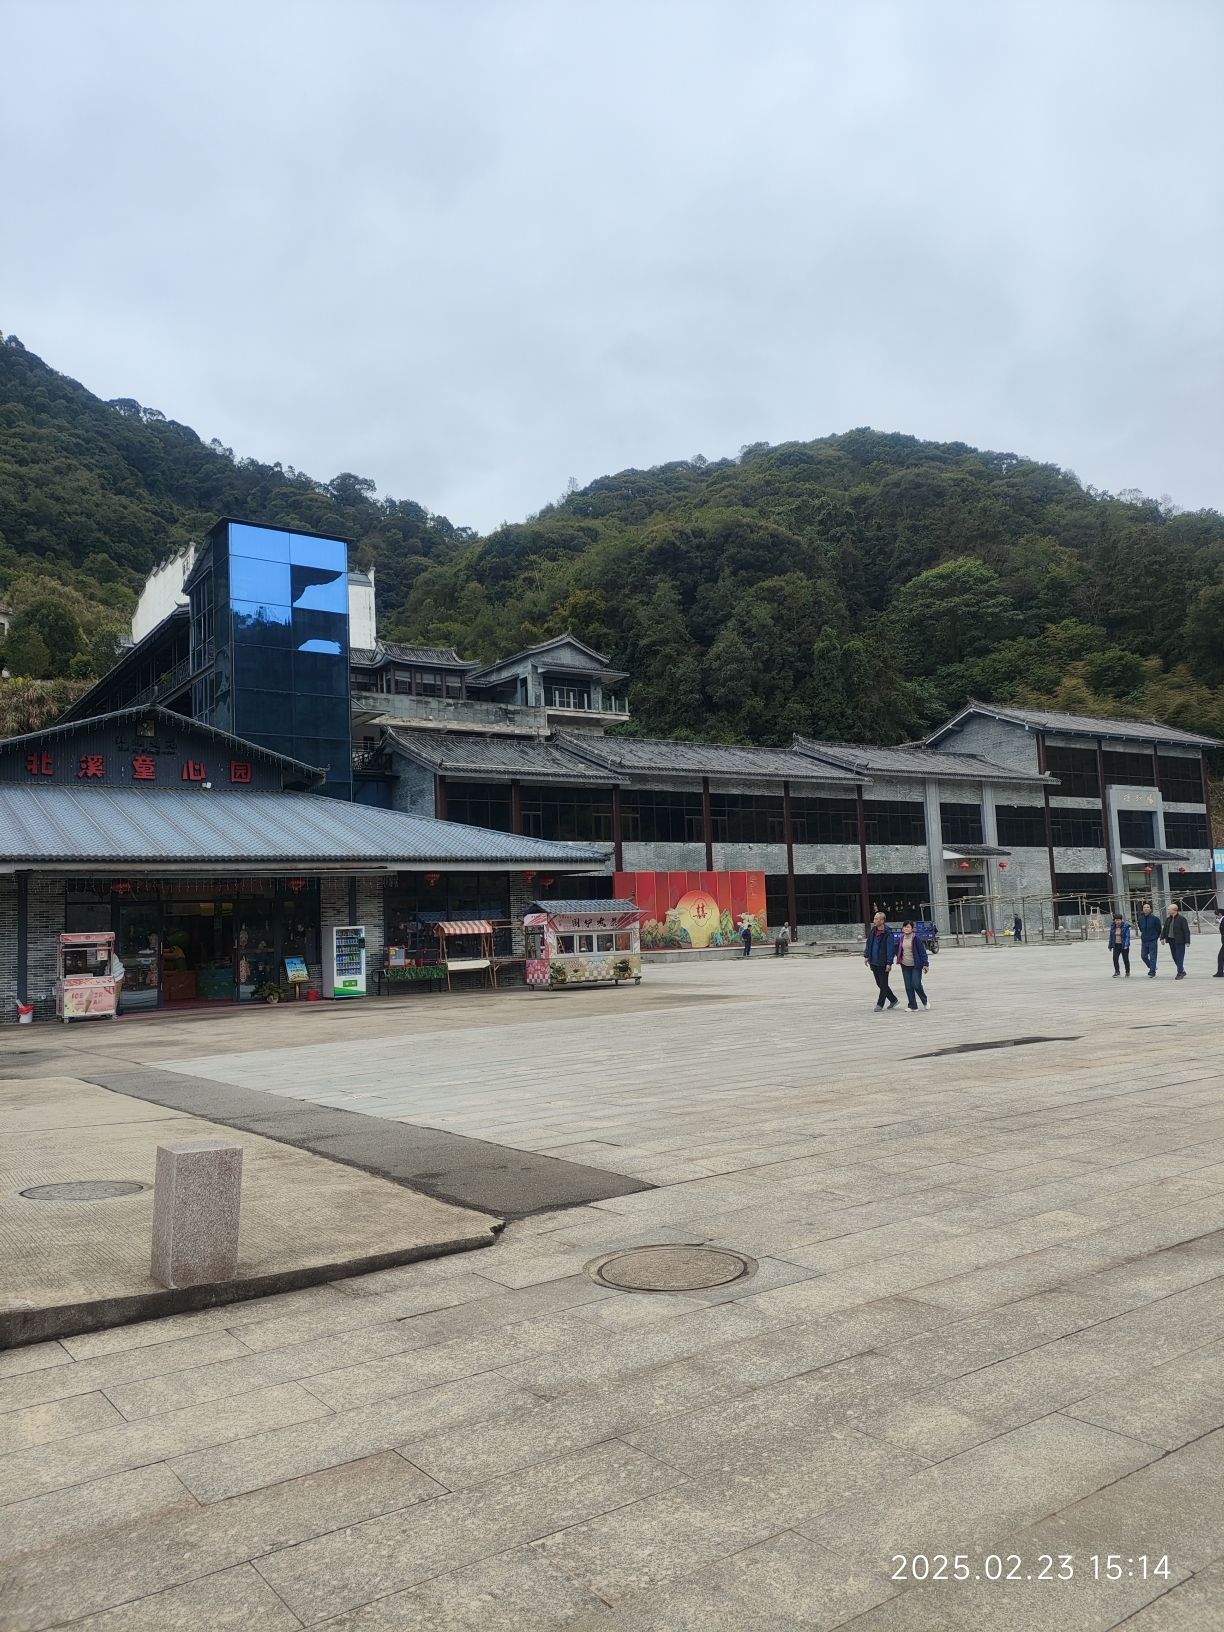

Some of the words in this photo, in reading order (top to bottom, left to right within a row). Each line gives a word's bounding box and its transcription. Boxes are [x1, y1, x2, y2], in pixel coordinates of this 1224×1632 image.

[26, 753, 252, 783] 北溪童心园
